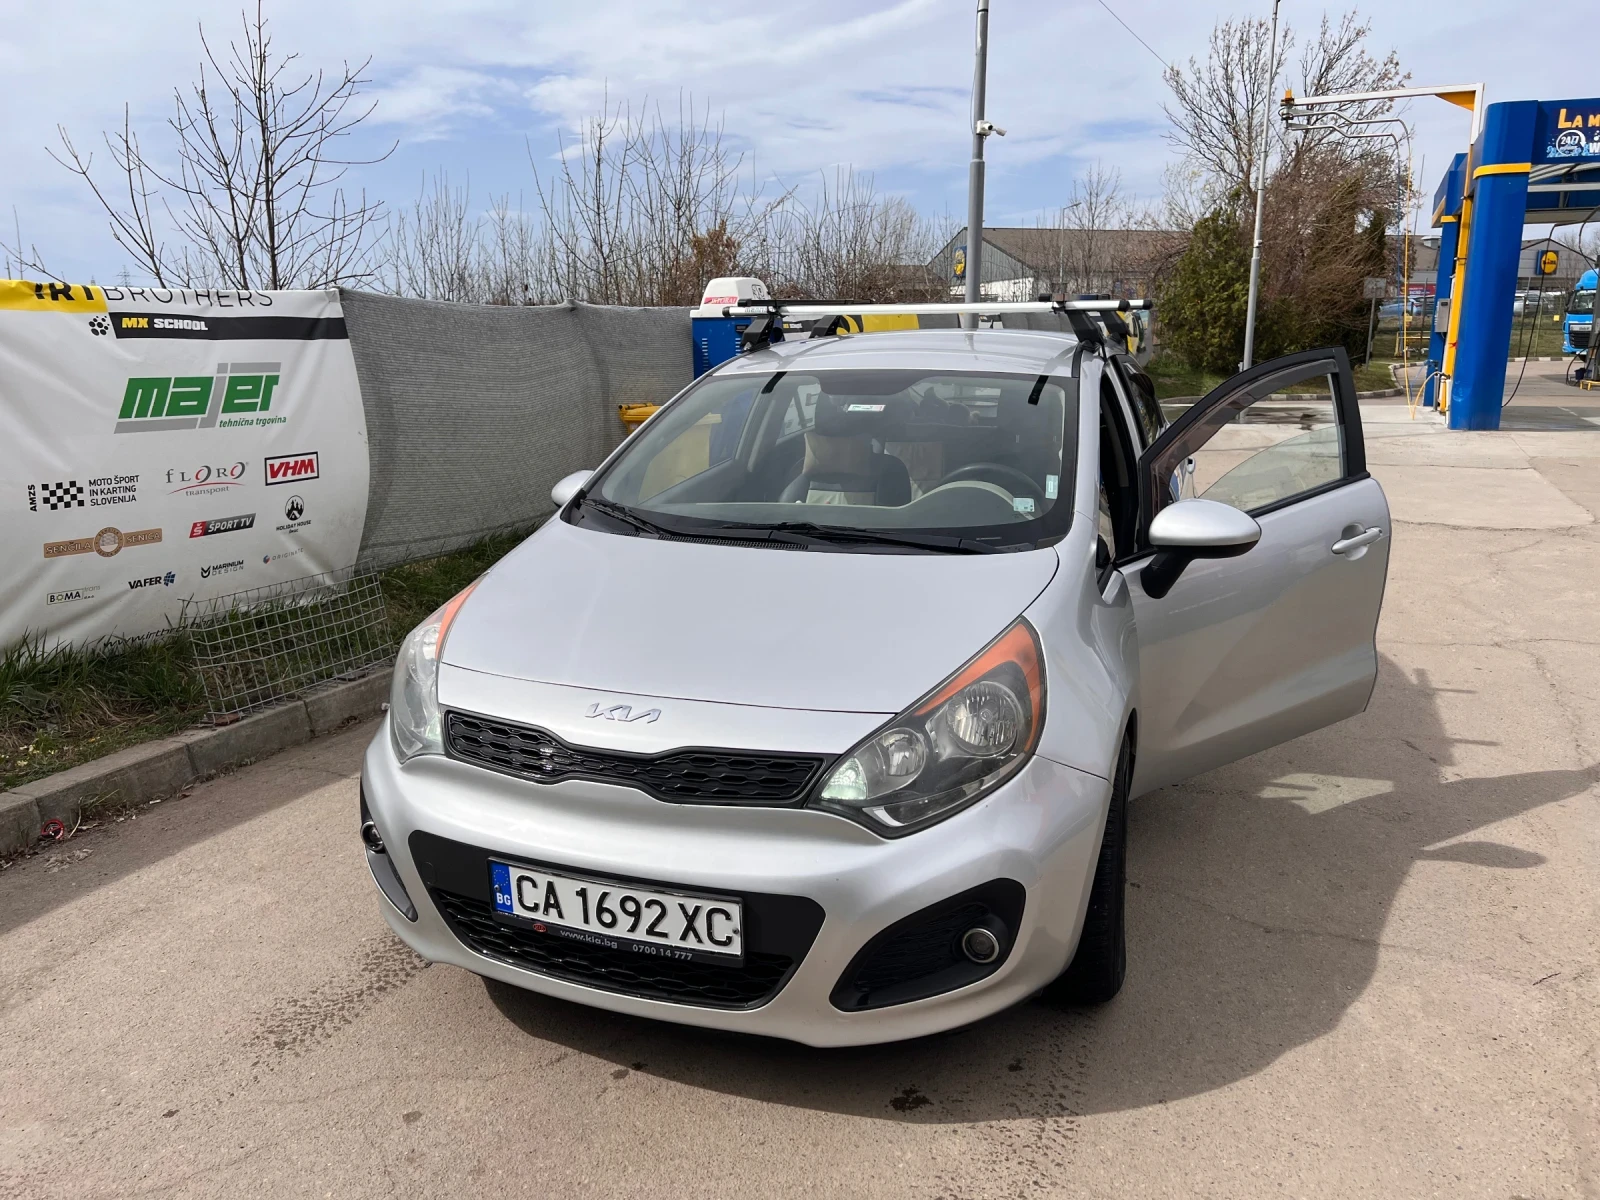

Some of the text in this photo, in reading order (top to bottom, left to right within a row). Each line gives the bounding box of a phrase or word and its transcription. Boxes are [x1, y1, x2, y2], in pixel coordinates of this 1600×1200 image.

[121, 317, 209, 331] MX SCHOOL
[219, 416, 287, 428] tehnična trgovina
[268, 458, 316, 479] VHM
[88, 475, 139, 487] MOTO ŠPORT
[27, 484, 37, 512] AMZS
[89, 485, 137, 497] IN KARTING
[90, 494, 137, 507] SLOVENIJA
[207, 516, 253, 533] ŠPORT TV
[276, 520, 312, 532] HOLIDAY HOUSE
[46, 541, 91, 554] SENČILA
[126, 532, 160, 544] SENICA
[211, 565, 244, 576] DESIGN
[128, 576, 162, 590] VAFER
[49, 591, 81, 603] BOMA
[585, 702, 662, 724] KIA
[496, 892, 511, 906] BG
[516, 874, 733, 948] CA 1692 XC
[560, 930, 693, 961] www.kia.bg 0700 14 777
